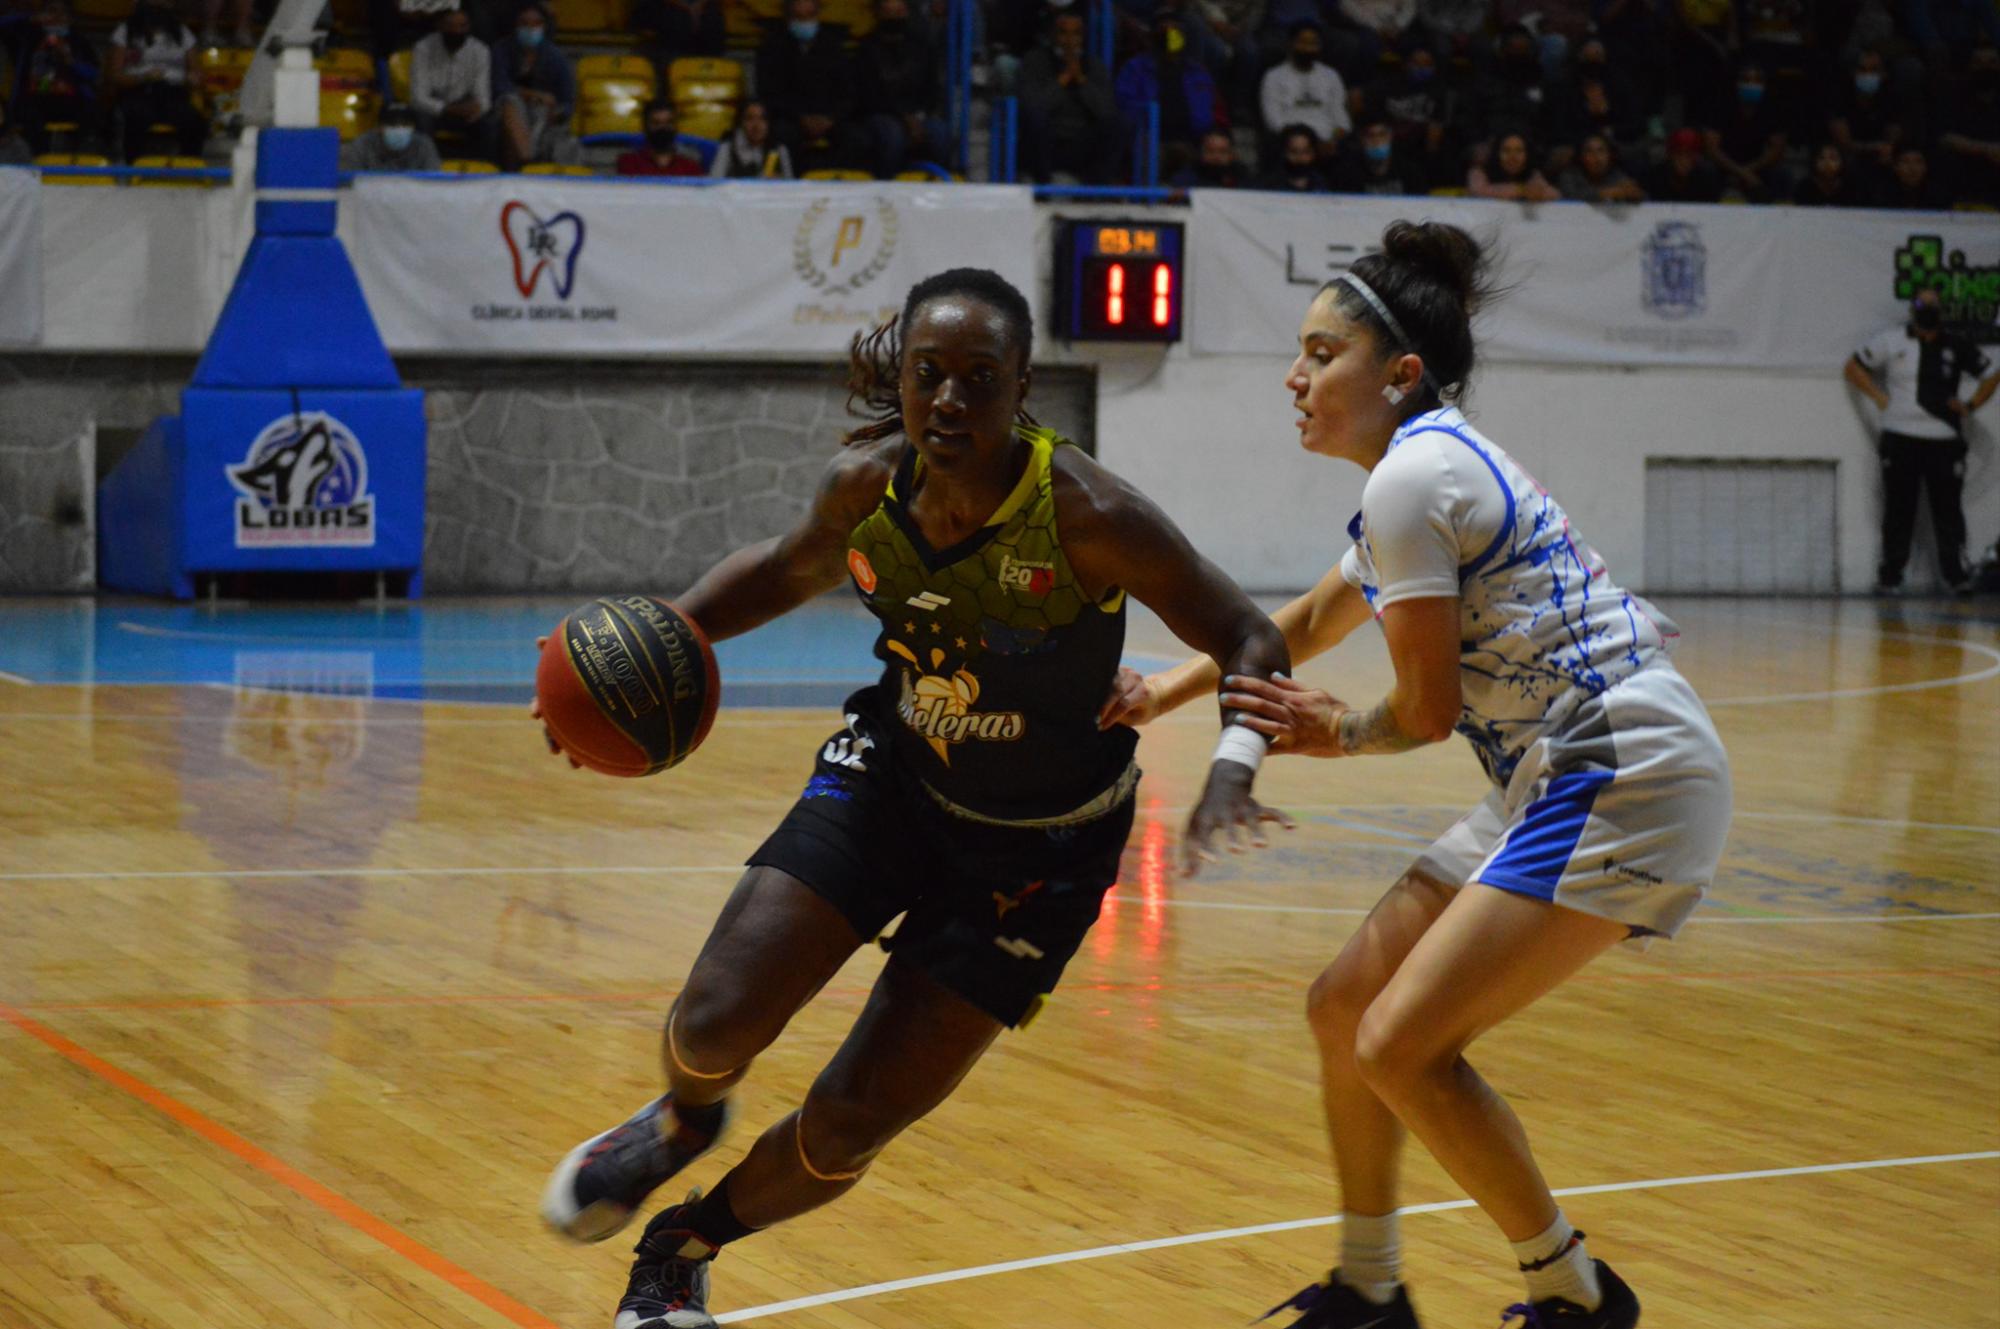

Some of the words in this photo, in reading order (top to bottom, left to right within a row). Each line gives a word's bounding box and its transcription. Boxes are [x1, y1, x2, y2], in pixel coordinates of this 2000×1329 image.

[832, 217, 864, 267] P
[528, 305, 574, 320] DENTAL
[617, 596, 697, 701] SPALDING
